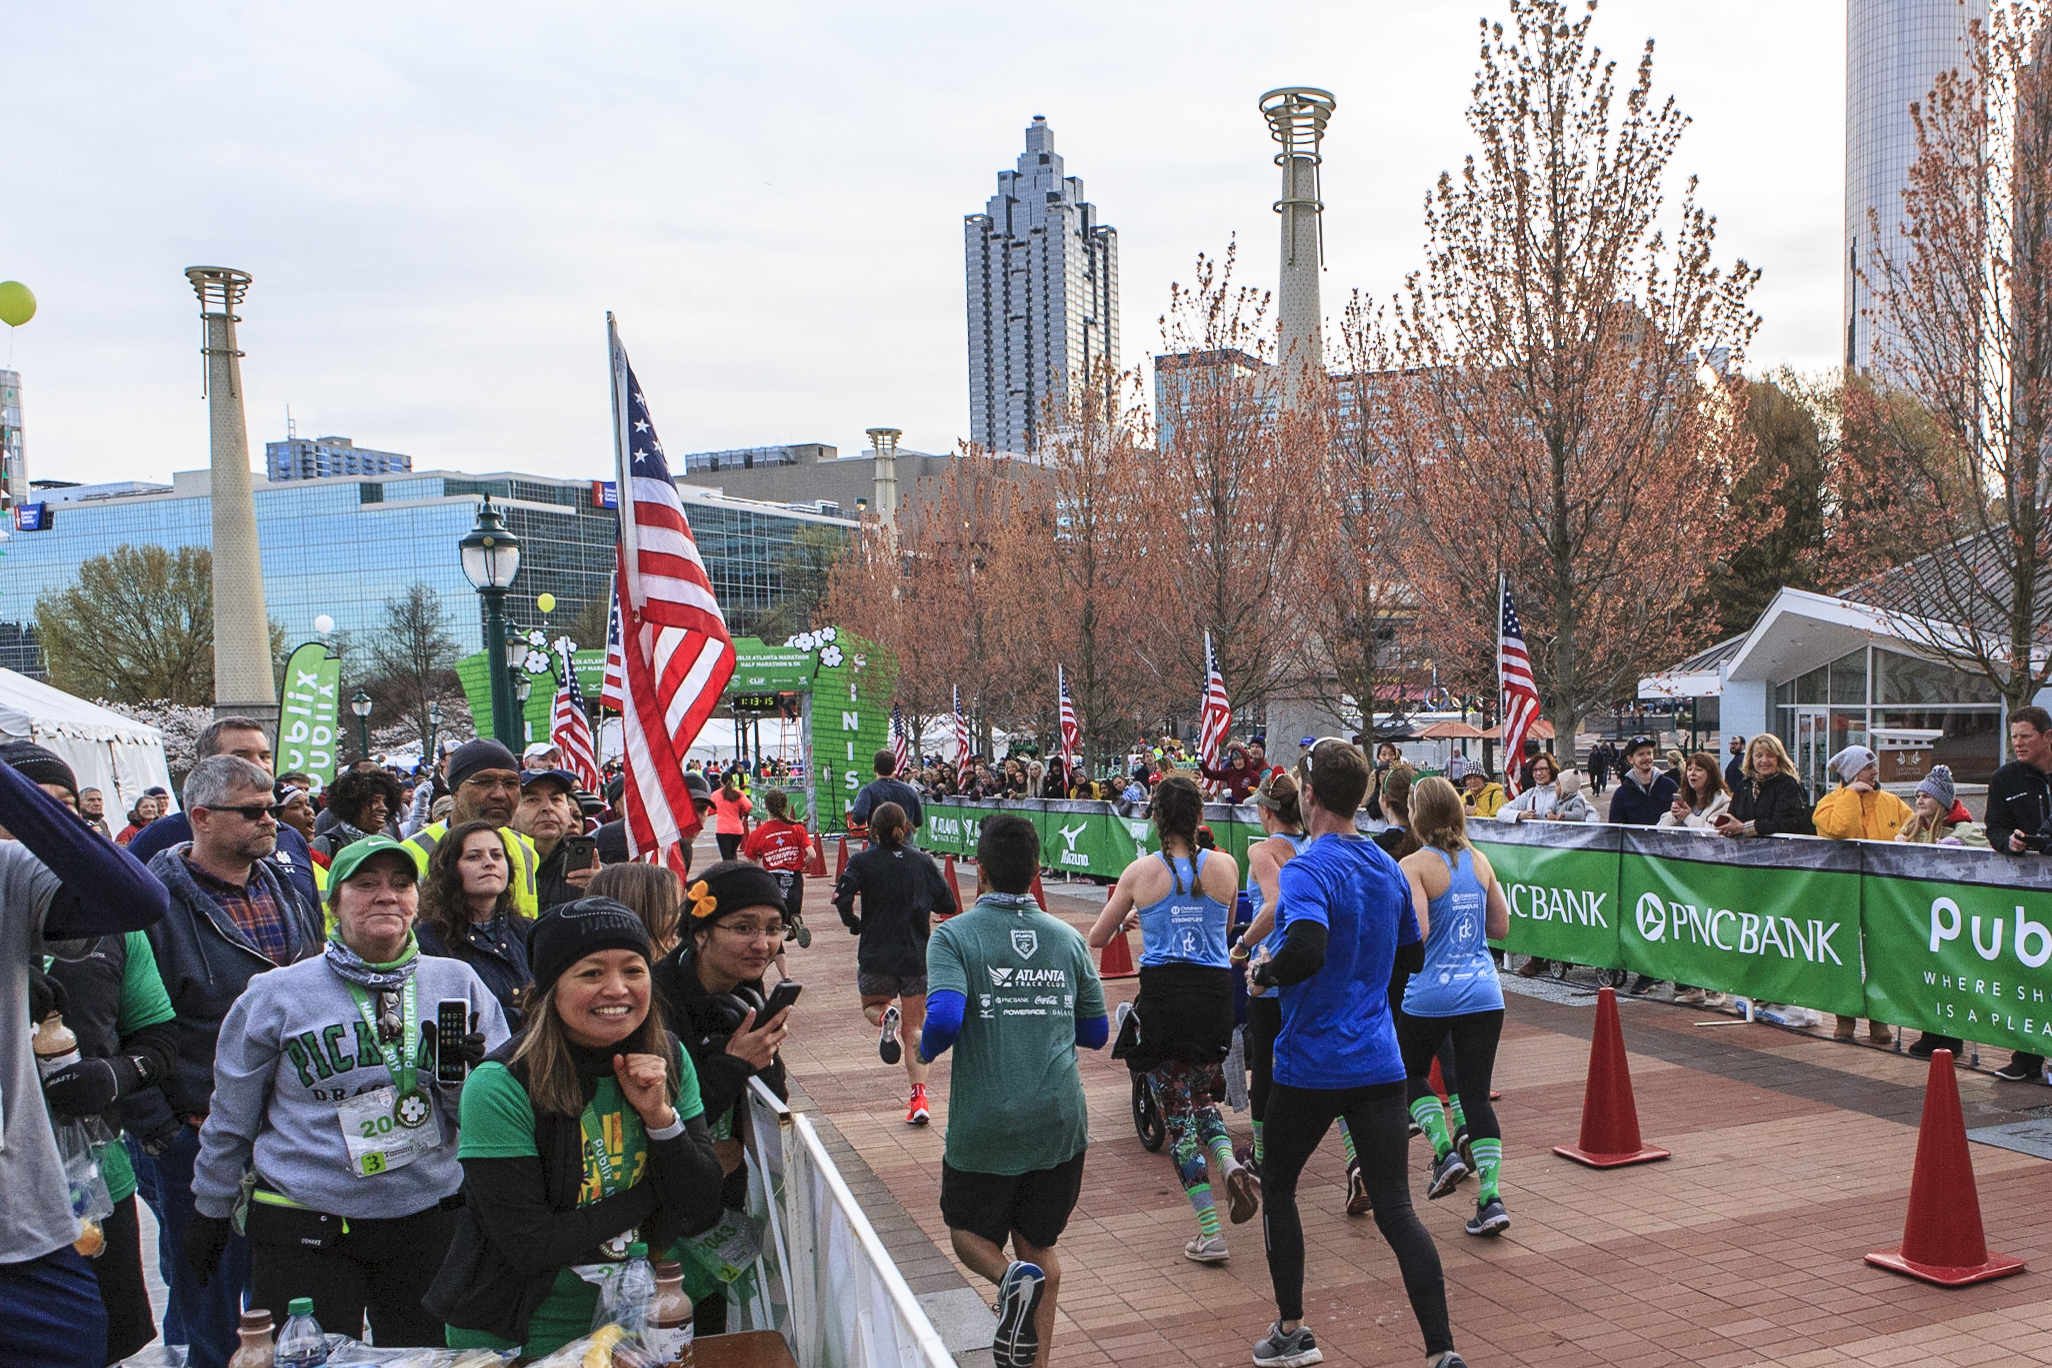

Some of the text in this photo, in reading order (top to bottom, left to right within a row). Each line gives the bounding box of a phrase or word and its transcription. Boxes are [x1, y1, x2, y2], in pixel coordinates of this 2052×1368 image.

[284, 669, 318, 770] ublix
[1497, 881, 1608, 929] NCBANK
[1015, 969, 1065, 981] ATLANTA
[1923, 971, 2052, 1003] WHERE SH
[405, 985, 415, 1028] ATLANTA
[1003, 1008, 1047, 1016] POWERADE
[1936, 1002, 1954, 1018] IS
[1967, 1009, 1978, 1023] A
[367, 1155, 380, 1172] 3
[700, 1225, 738, 1250] 043
